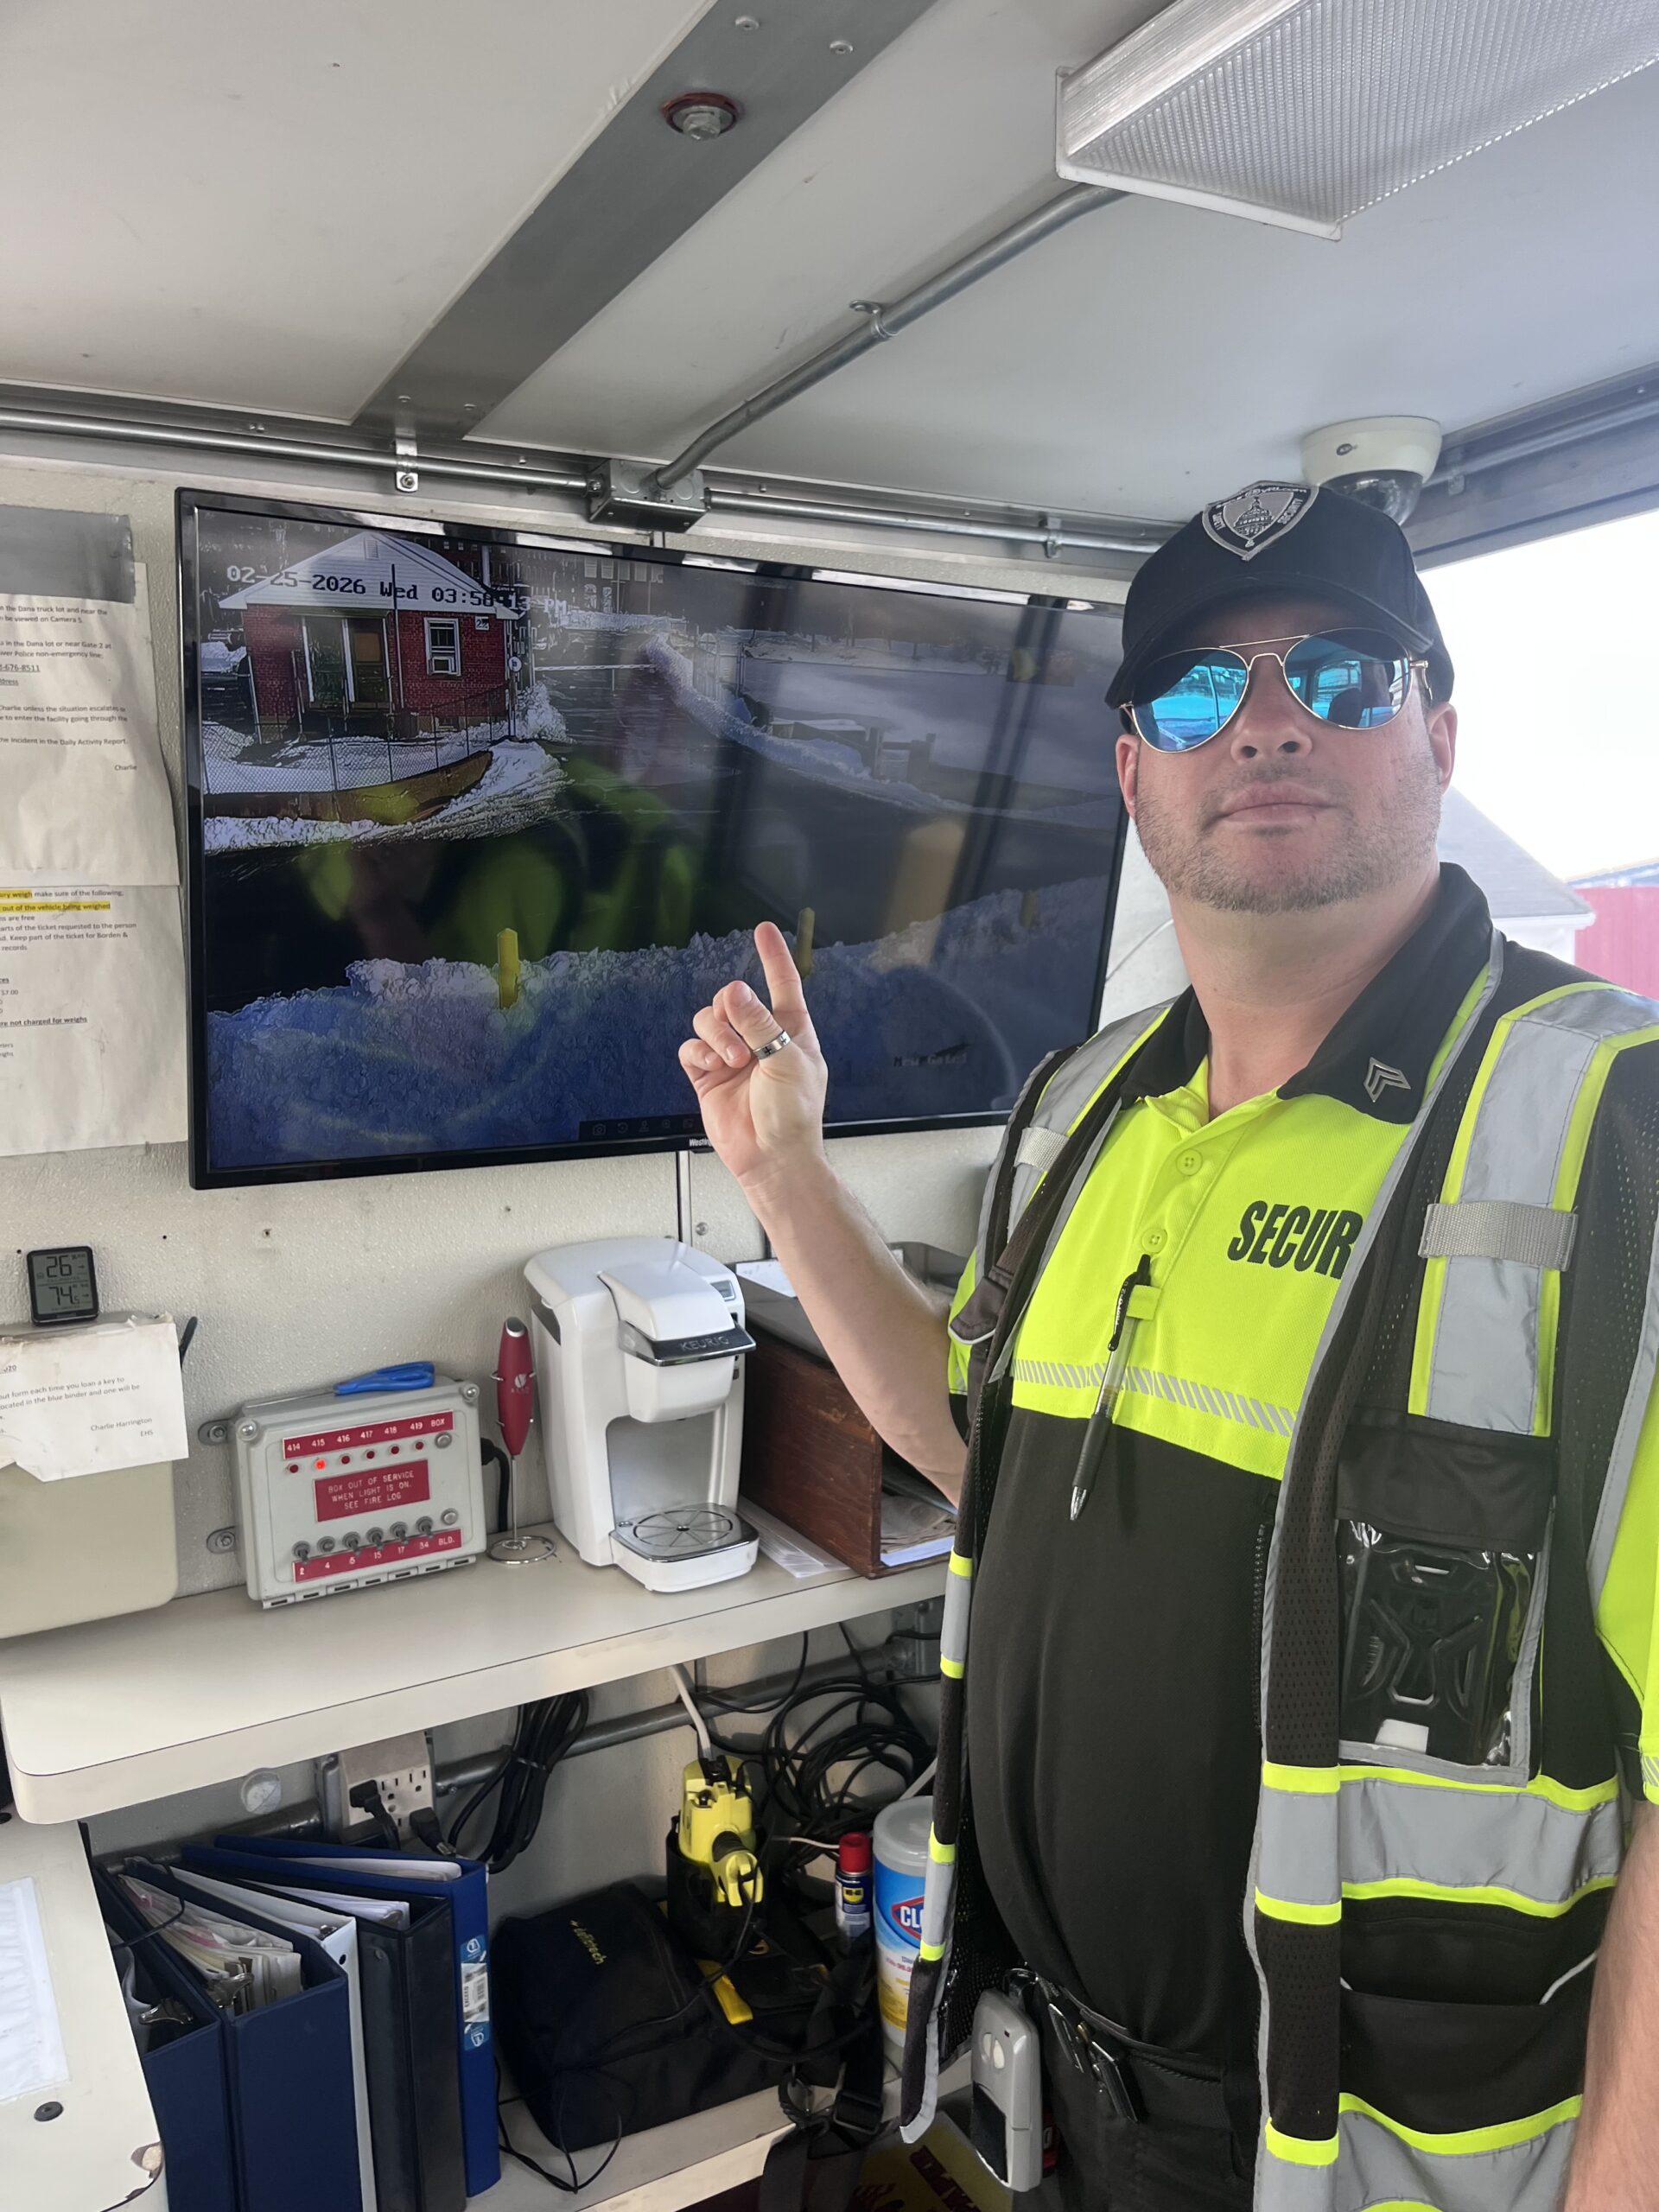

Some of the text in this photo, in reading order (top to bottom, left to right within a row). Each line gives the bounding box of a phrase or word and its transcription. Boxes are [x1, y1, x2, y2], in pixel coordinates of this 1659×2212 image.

[227, 564, 366, 595] 02-25-2026
[379, 581, 419, 601] Wed
[543, 598, 568, 613] PM
[1227, 1199, 1363, 1280] SECUR
[46, 1255, 72, 1277] 26
[680, 1336, 729, 1351] KEURIG
[48, 1383, 64, 1392] time
[103, 1377, 115, 1386] key
[48, 1394, 63, 1402] blue
[65, 1391, 87, 1400] binder
[118, 1384, 130, 1393] will
[90, 1416, 153, 1432] Charlie Harrington
[287, 1442, 301, 1452] 414
[311, 1438, 326, 1447] 415
[337, 1434, 351, 1443] 416
[360, 1430, 373, 1439] 417
[384, 1426, 397, 1434] 418
[430, 1418, 445, 1427] BOX
[328, 1470, 415, 1493] BOX OUT OF SERVICE
[332, 1491, 353, 1503] WHEN
[359, 1486, 381, 1497] LIGHT
[344, 1491, 402, 1510] SEE FIRE LOG
[299, 1567, 305, 1575] 2
[373, 1551, 382, 1560] 15
[397, 1546, 405, 1554] 17
[419, 1541, 429, 1549] 34
[438, 1535, 455, 1546] BLD.
[900, 1905, 923, 1928] CL
